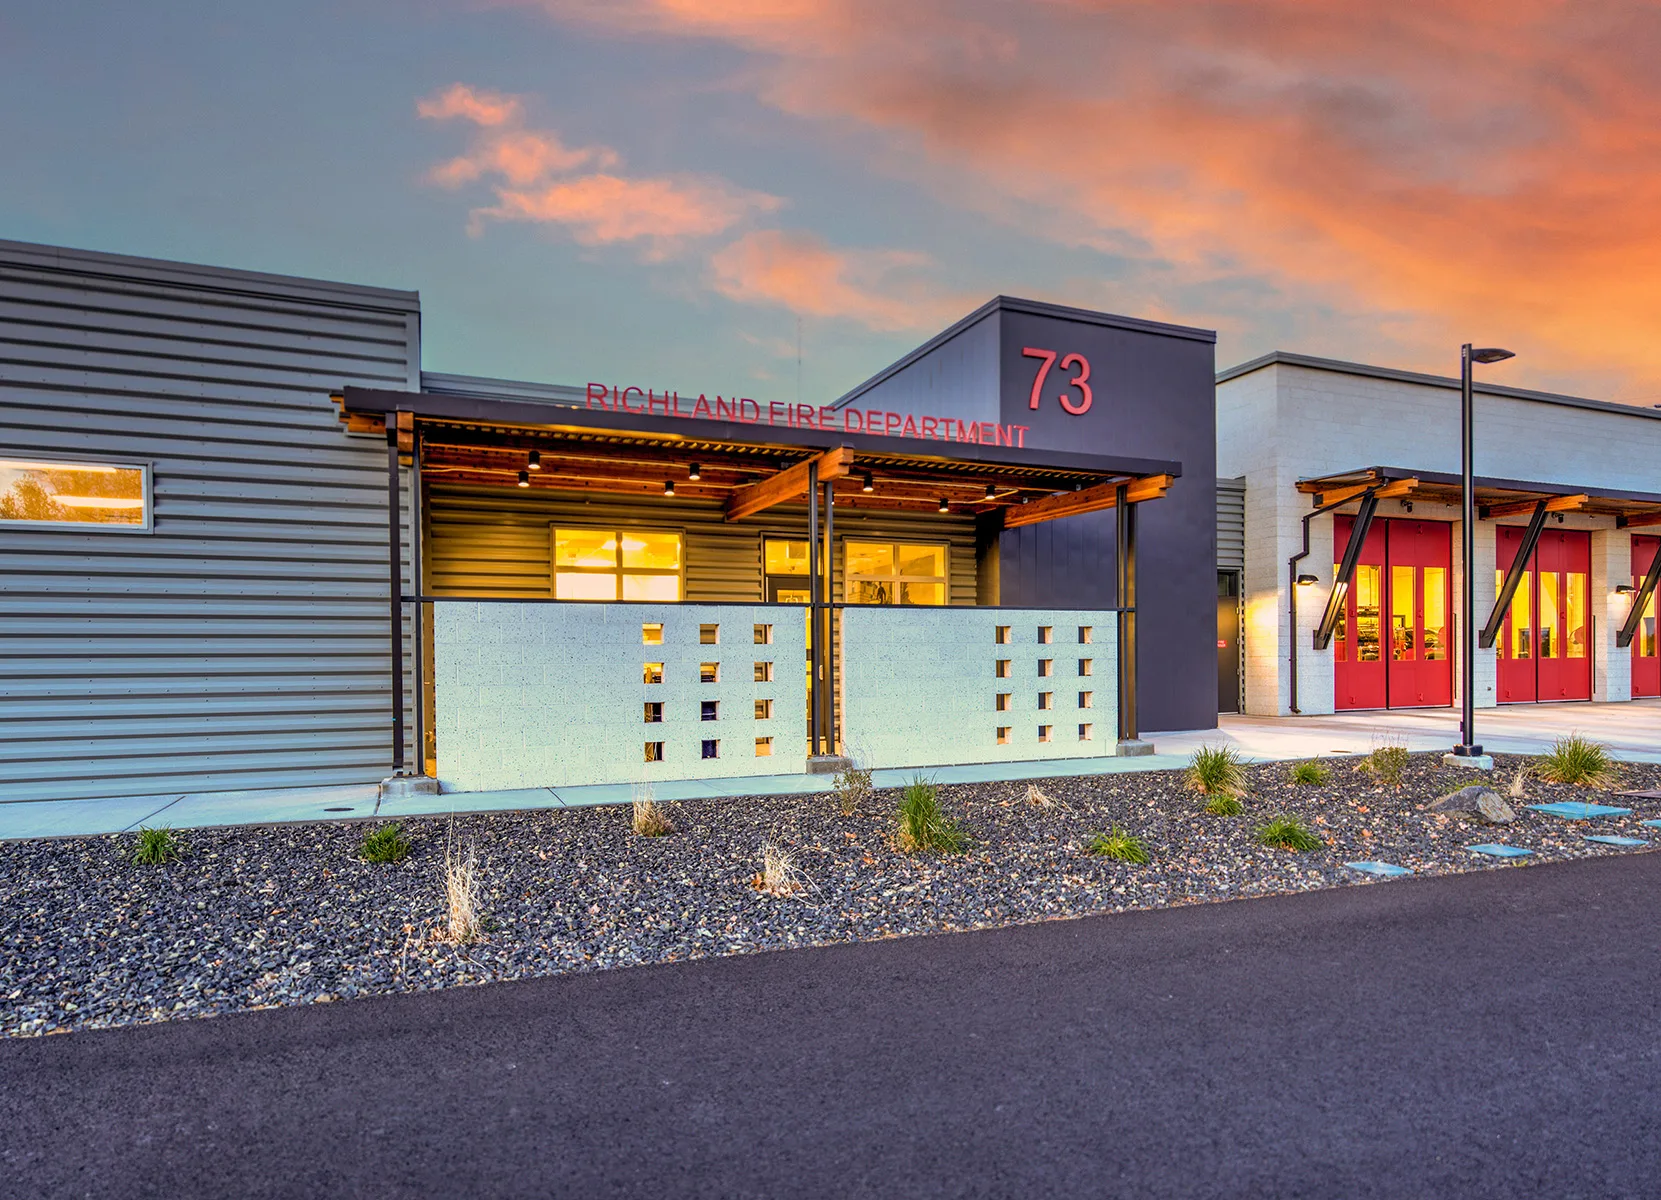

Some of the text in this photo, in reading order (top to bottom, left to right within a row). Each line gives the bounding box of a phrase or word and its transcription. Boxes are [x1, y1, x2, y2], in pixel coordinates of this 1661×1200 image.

[1022, 347, 1093, 415] 73
[586, 383, 1030, 448] RICHLAND FIRE DEPARTMENT
